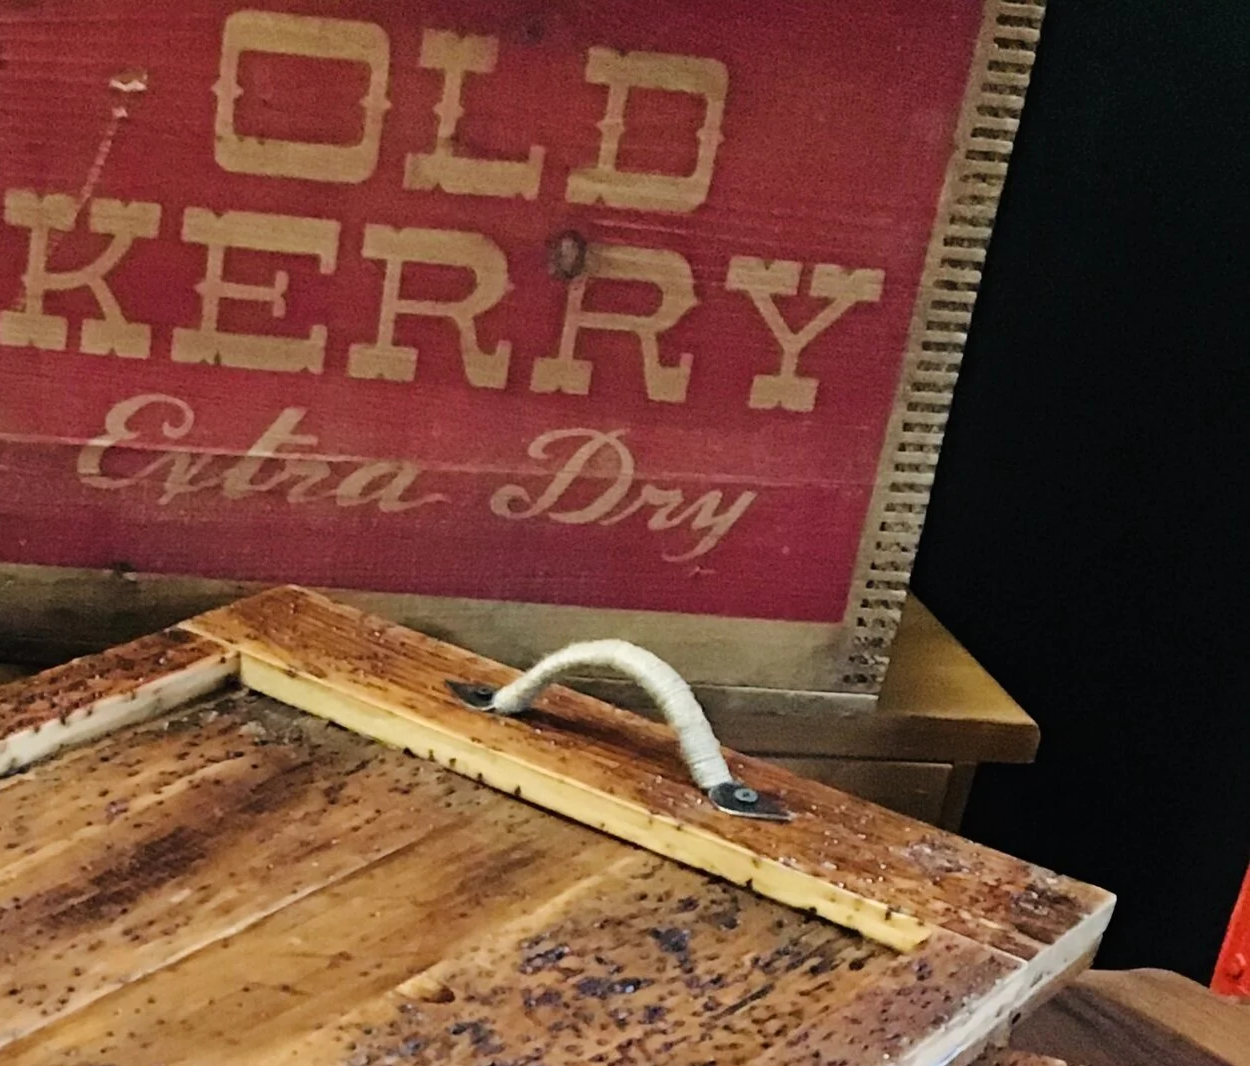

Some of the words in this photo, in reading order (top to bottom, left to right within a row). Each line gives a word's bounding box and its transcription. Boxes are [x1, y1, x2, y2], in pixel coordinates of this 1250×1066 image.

[212, 10, 728, 213] OLD
[77, 394, 447, 514] Extra
[491, 428, 756, 562] Dry
